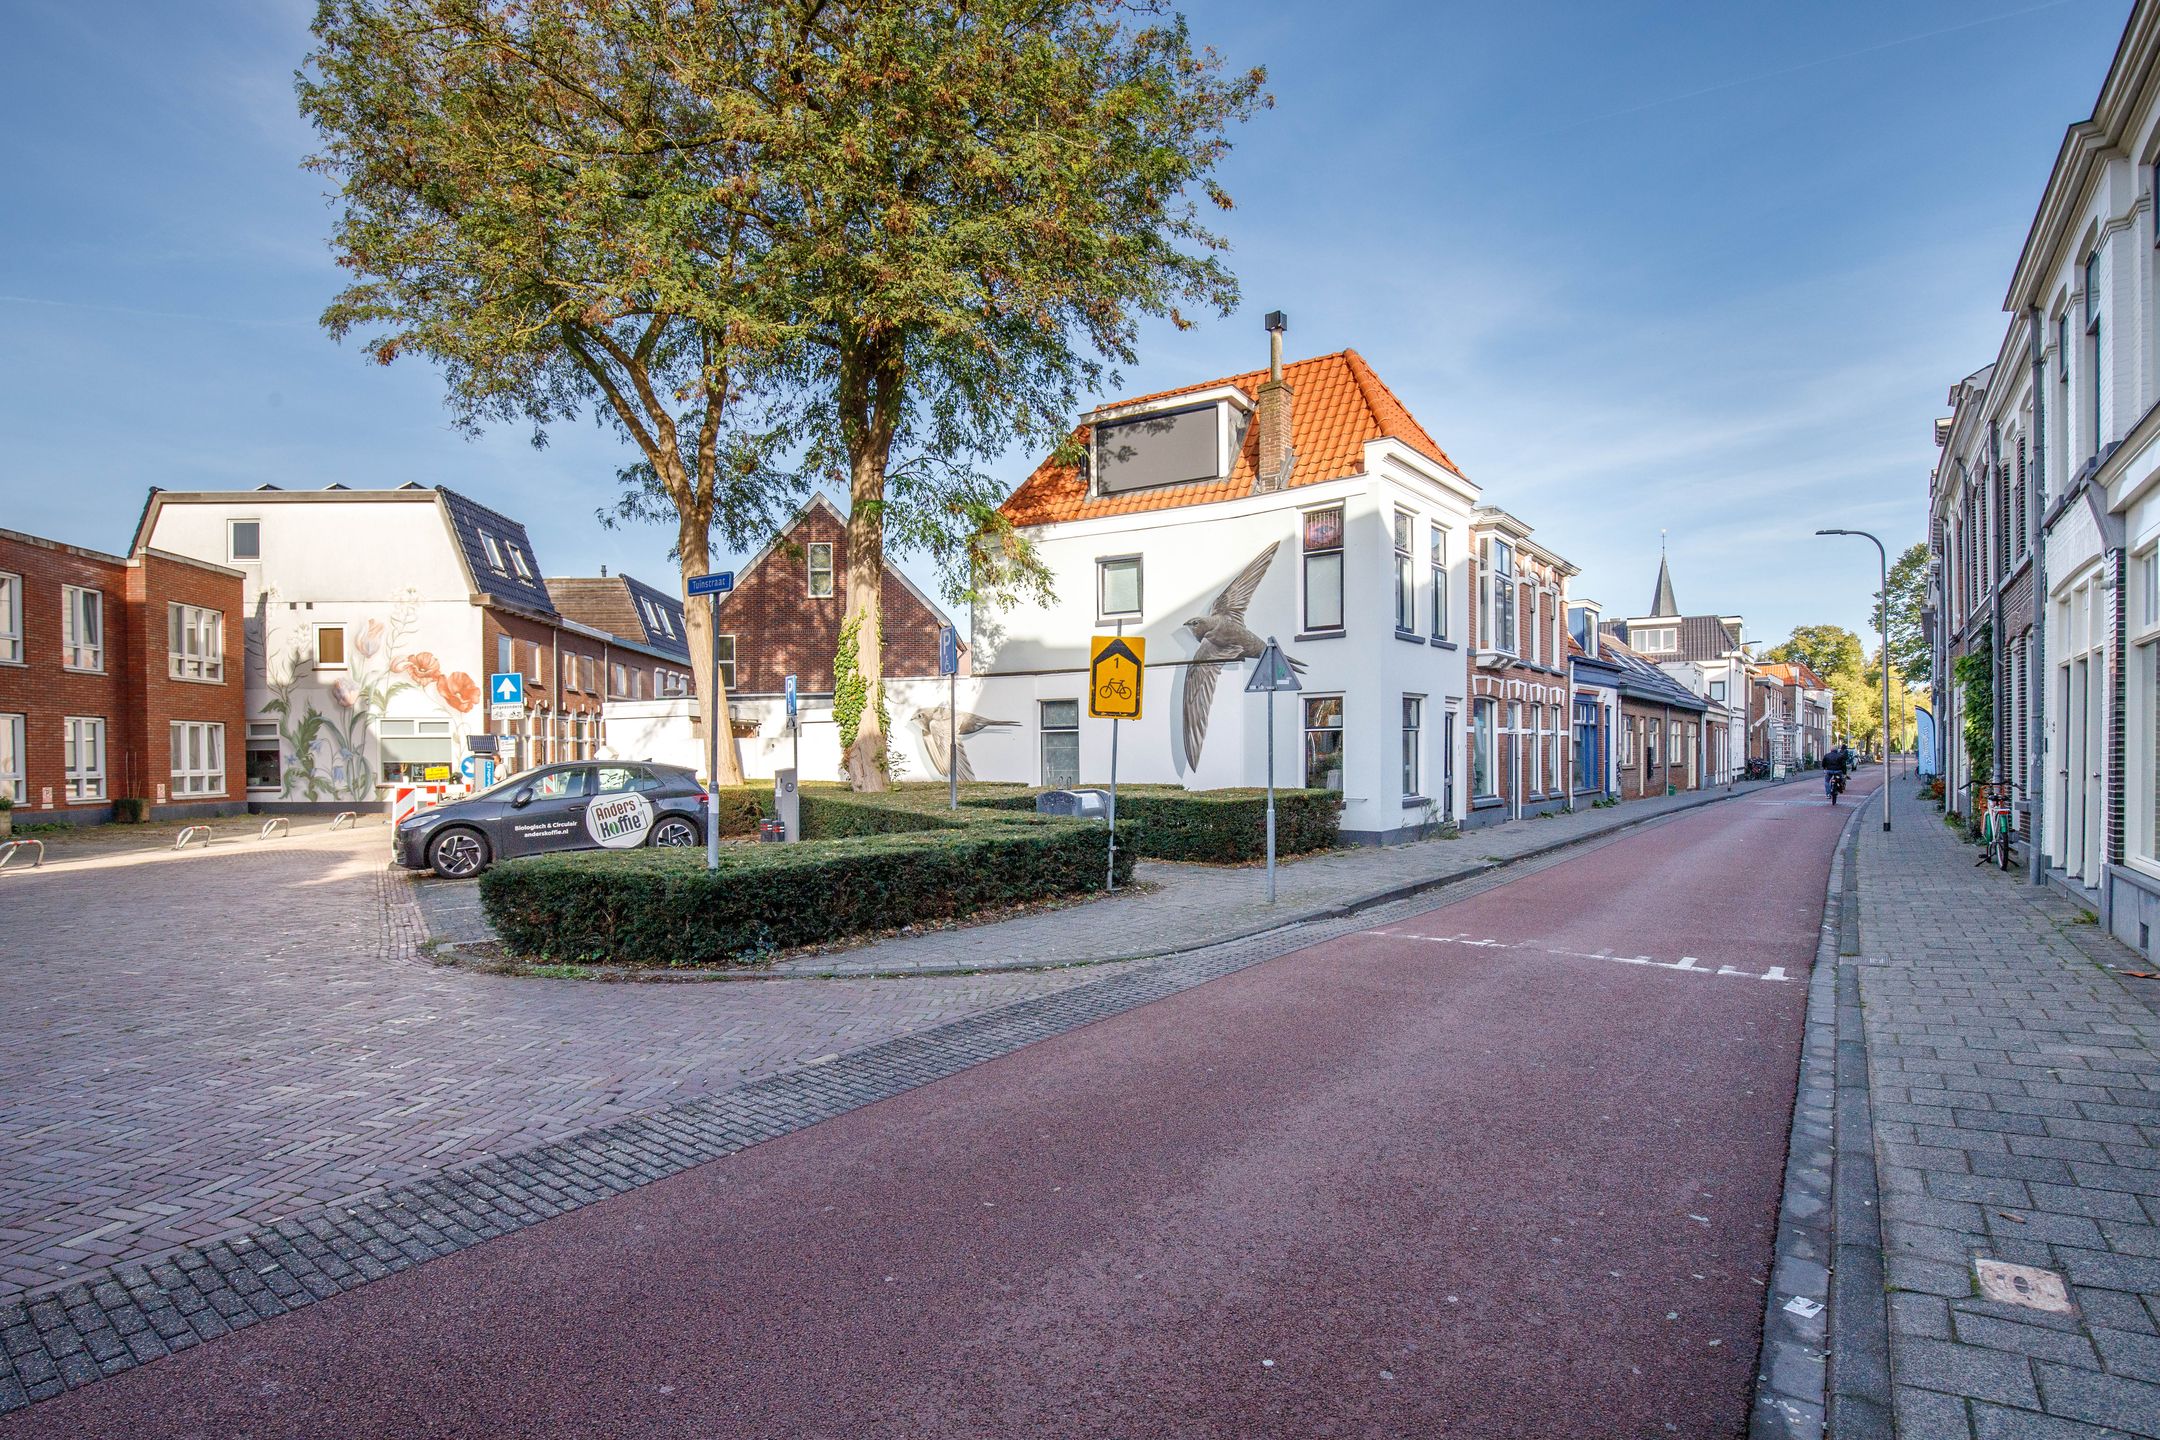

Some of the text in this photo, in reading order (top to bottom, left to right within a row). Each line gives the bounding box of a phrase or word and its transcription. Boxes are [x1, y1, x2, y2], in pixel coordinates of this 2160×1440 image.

[692, 578, 726, 590] Tuinstraat
[943, 631, 951, 656] P
[1113, 657, 1119, 669] 1
[787, 680, 793, 699] P
[595, 800, 636, 821] Anders
[514, 823, 546, 831] Biologisch
[524, 829, 569, 838] anderskoffie.nl
[600, 814, 642, 839] Koffie
